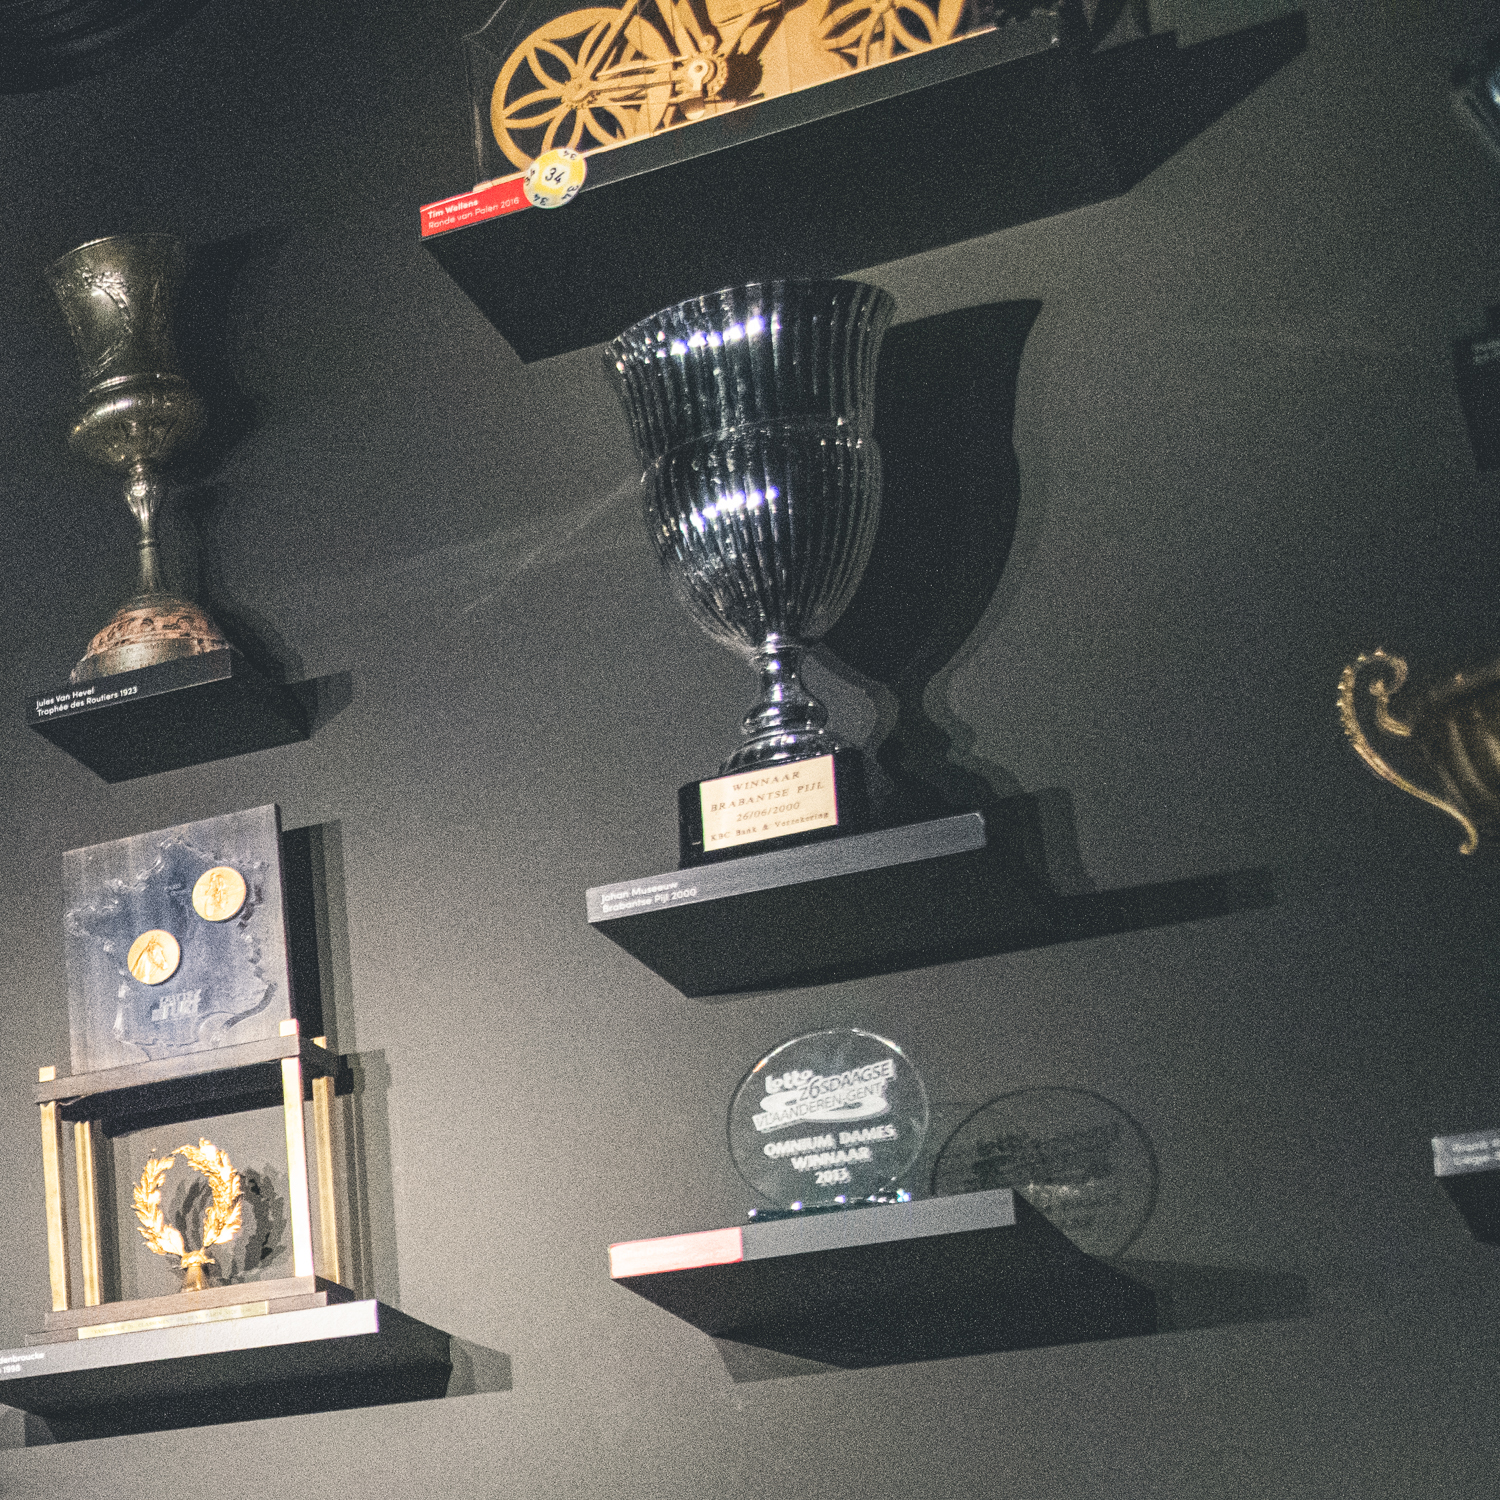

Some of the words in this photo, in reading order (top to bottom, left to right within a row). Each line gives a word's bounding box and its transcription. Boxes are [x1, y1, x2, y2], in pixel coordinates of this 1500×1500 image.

[544, 167, 566, 185] 34
[427, 210, 444, 220] Tim
[445, 199, 479, 214] Wellens
[428, 217, 455, 229] Ronde
[456, 212, 473, 221] van
[474, 205, 499, 216] Polen
[501, 197, 520, 209] 2016
[35, 697, 55, 710] Jules
[56, 693, 71, 703] Van
[72, 685, 95, 699] Hevel
[37, 703, 69, 717] Trophée
[70, 699, 85, 709] des
[86, 690, 119, 705] Routiers
[120, 685, 138, 697] 1923
[732, 770, 800, 791] WINNAAR
[710, 788, 790, 813] BRABANTSE
[797, 781, 825, 794] PIJL
[736, 801, 801, 822] 26/06/2000
[710, 832, 731, 842] KBC
[735, 826, 757, 836] Bank
[601, 891, 629, 905] Johan
[631, 882, 678, 897] Museeuw
[602, 898, 653, 913] Brabantse
[654, 893, 669, 904] Pijl
[671, 887, 697, 900] 2000
[763, 1134, 836, 1158] OMNIUM
[839, 1124, 896, 1146] DAMES
[790, 1147, 871, 1171] WINNAAR
[815, 1168, 850, 1186] 2013
